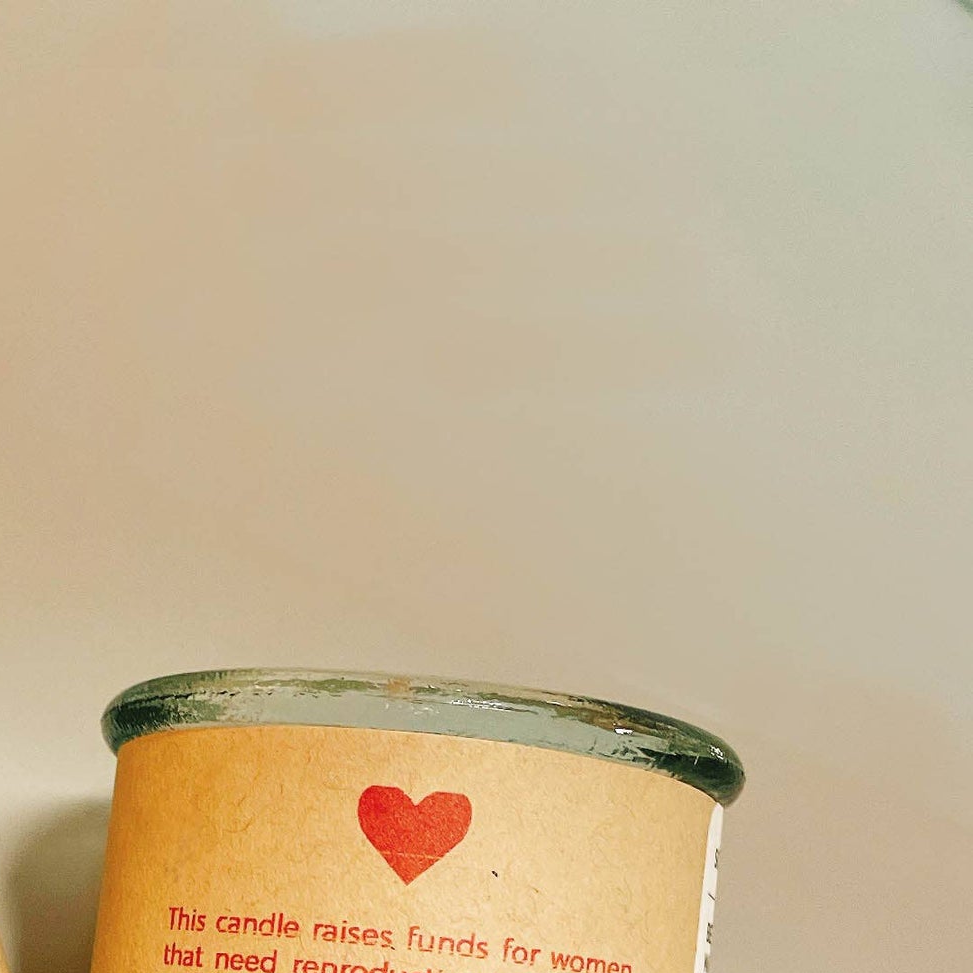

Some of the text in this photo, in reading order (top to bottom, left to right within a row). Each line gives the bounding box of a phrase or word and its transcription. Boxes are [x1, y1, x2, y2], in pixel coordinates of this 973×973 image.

[164, 943, 203, 967] that
[215, 949, 277, 973] need
[169, 906, 206, 932] This
[216, 912, 301, 938] candle
[313, 920, 392, 948] raises
[408, 926, 488, 958] funds
[503, 938, 541, 966] for
